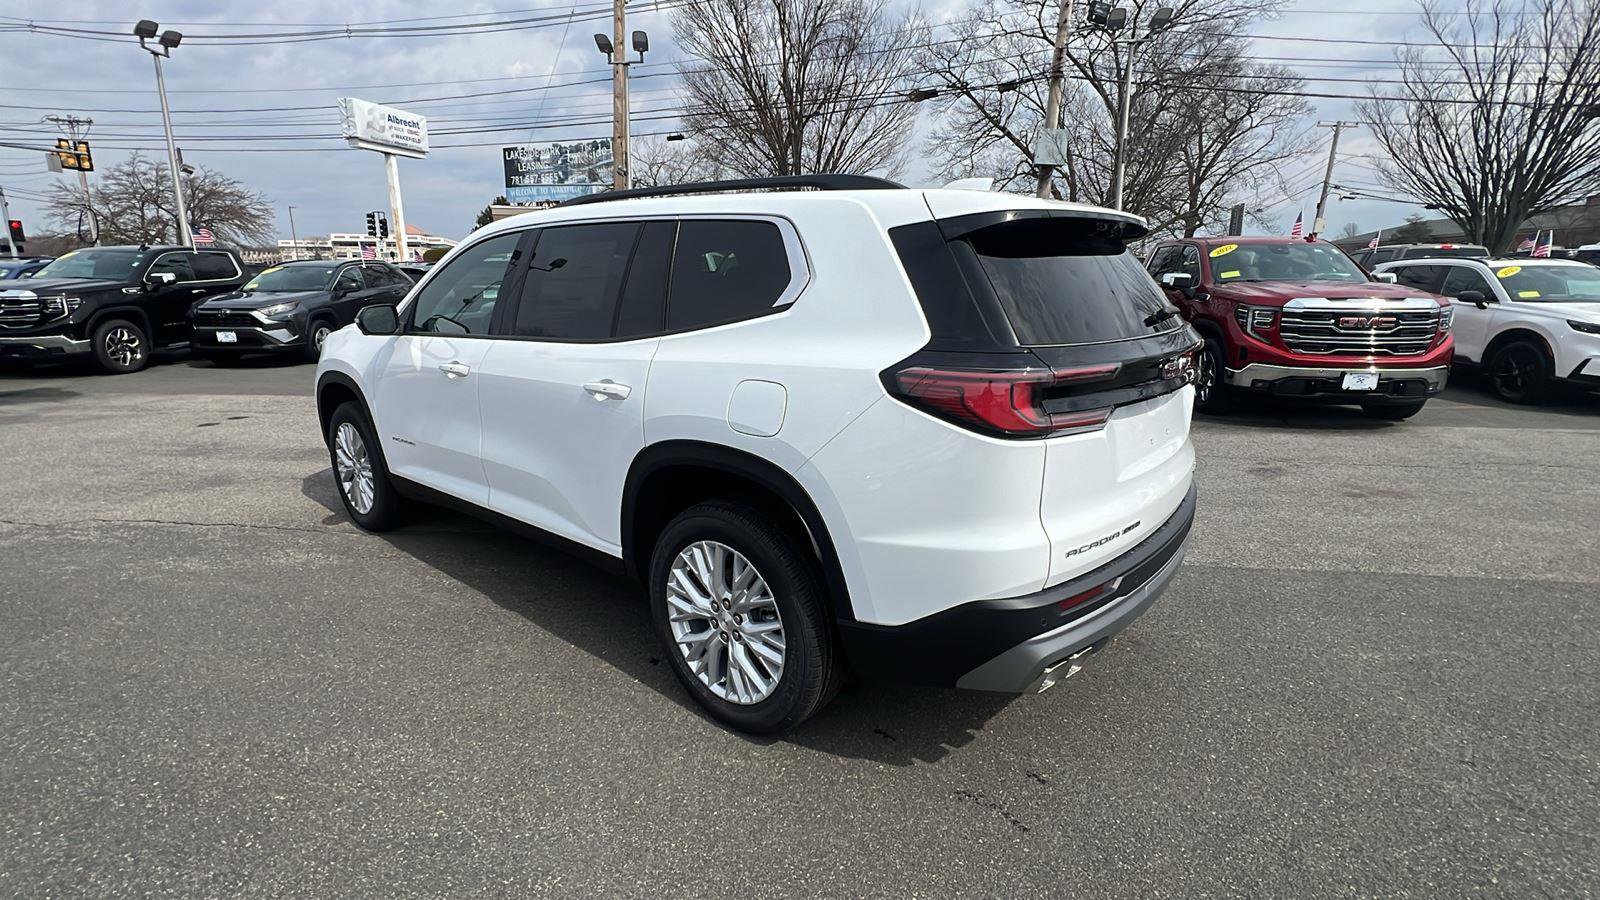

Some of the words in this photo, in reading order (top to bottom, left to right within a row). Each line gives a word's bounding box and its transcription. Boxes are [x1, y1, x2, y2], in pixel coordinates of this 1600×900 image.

[387, 114, 420, 129] Albrecht
[506, 149, 539, 160] LAKESIDE
[541, 145, 561, 158] PARK
[518, 160, 549, 172] LEASING
[1339, 317, 1397, 328] GMC
[1065, 531, 1121, 559] ACADIA
